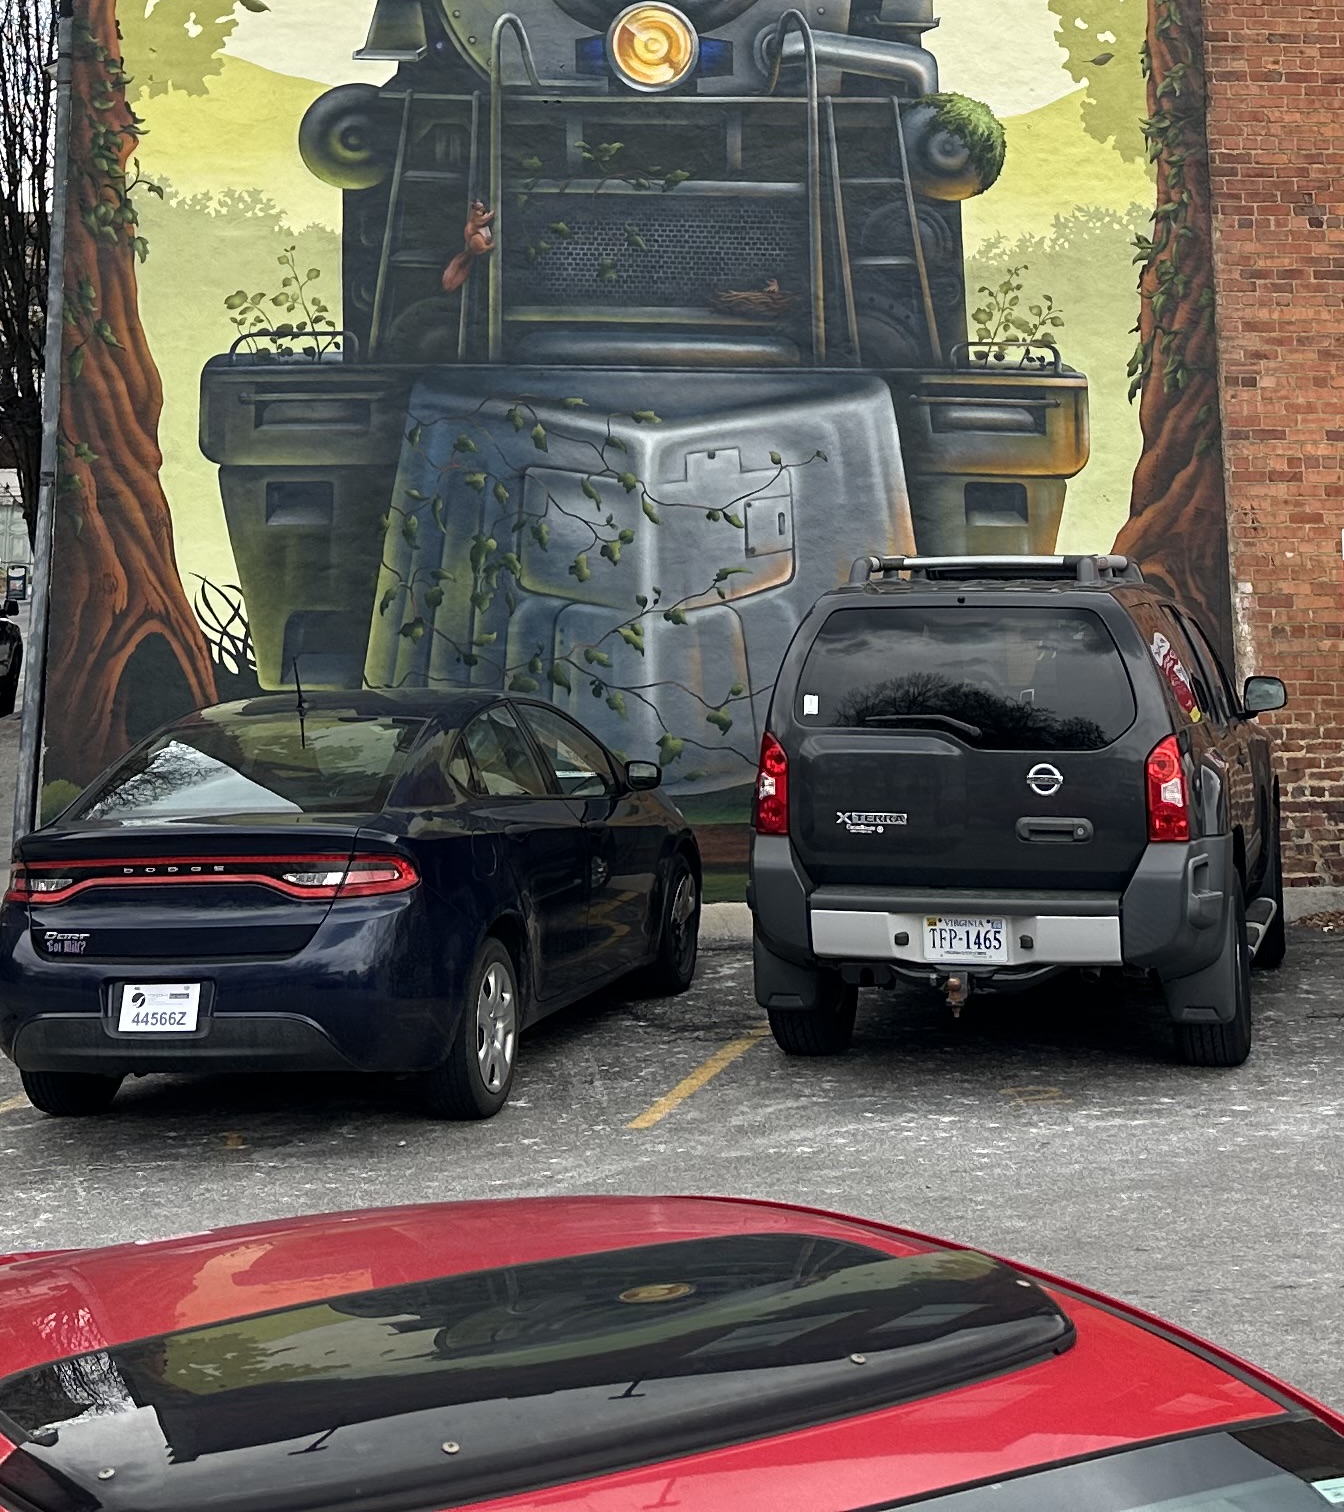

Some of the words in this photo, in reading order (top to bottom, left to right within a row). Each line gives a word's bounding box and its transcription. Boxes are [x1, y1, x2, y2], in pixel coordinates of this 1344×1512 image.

[836, 811, 908, 825] XTERRA
[123, 865, 225, 874] DODGE
[943, 918, 985, 928] VIRGINIA
[928, 928, 1003, 950] TFP-1465
[131, 1011, 187, 1026] 44566Z
